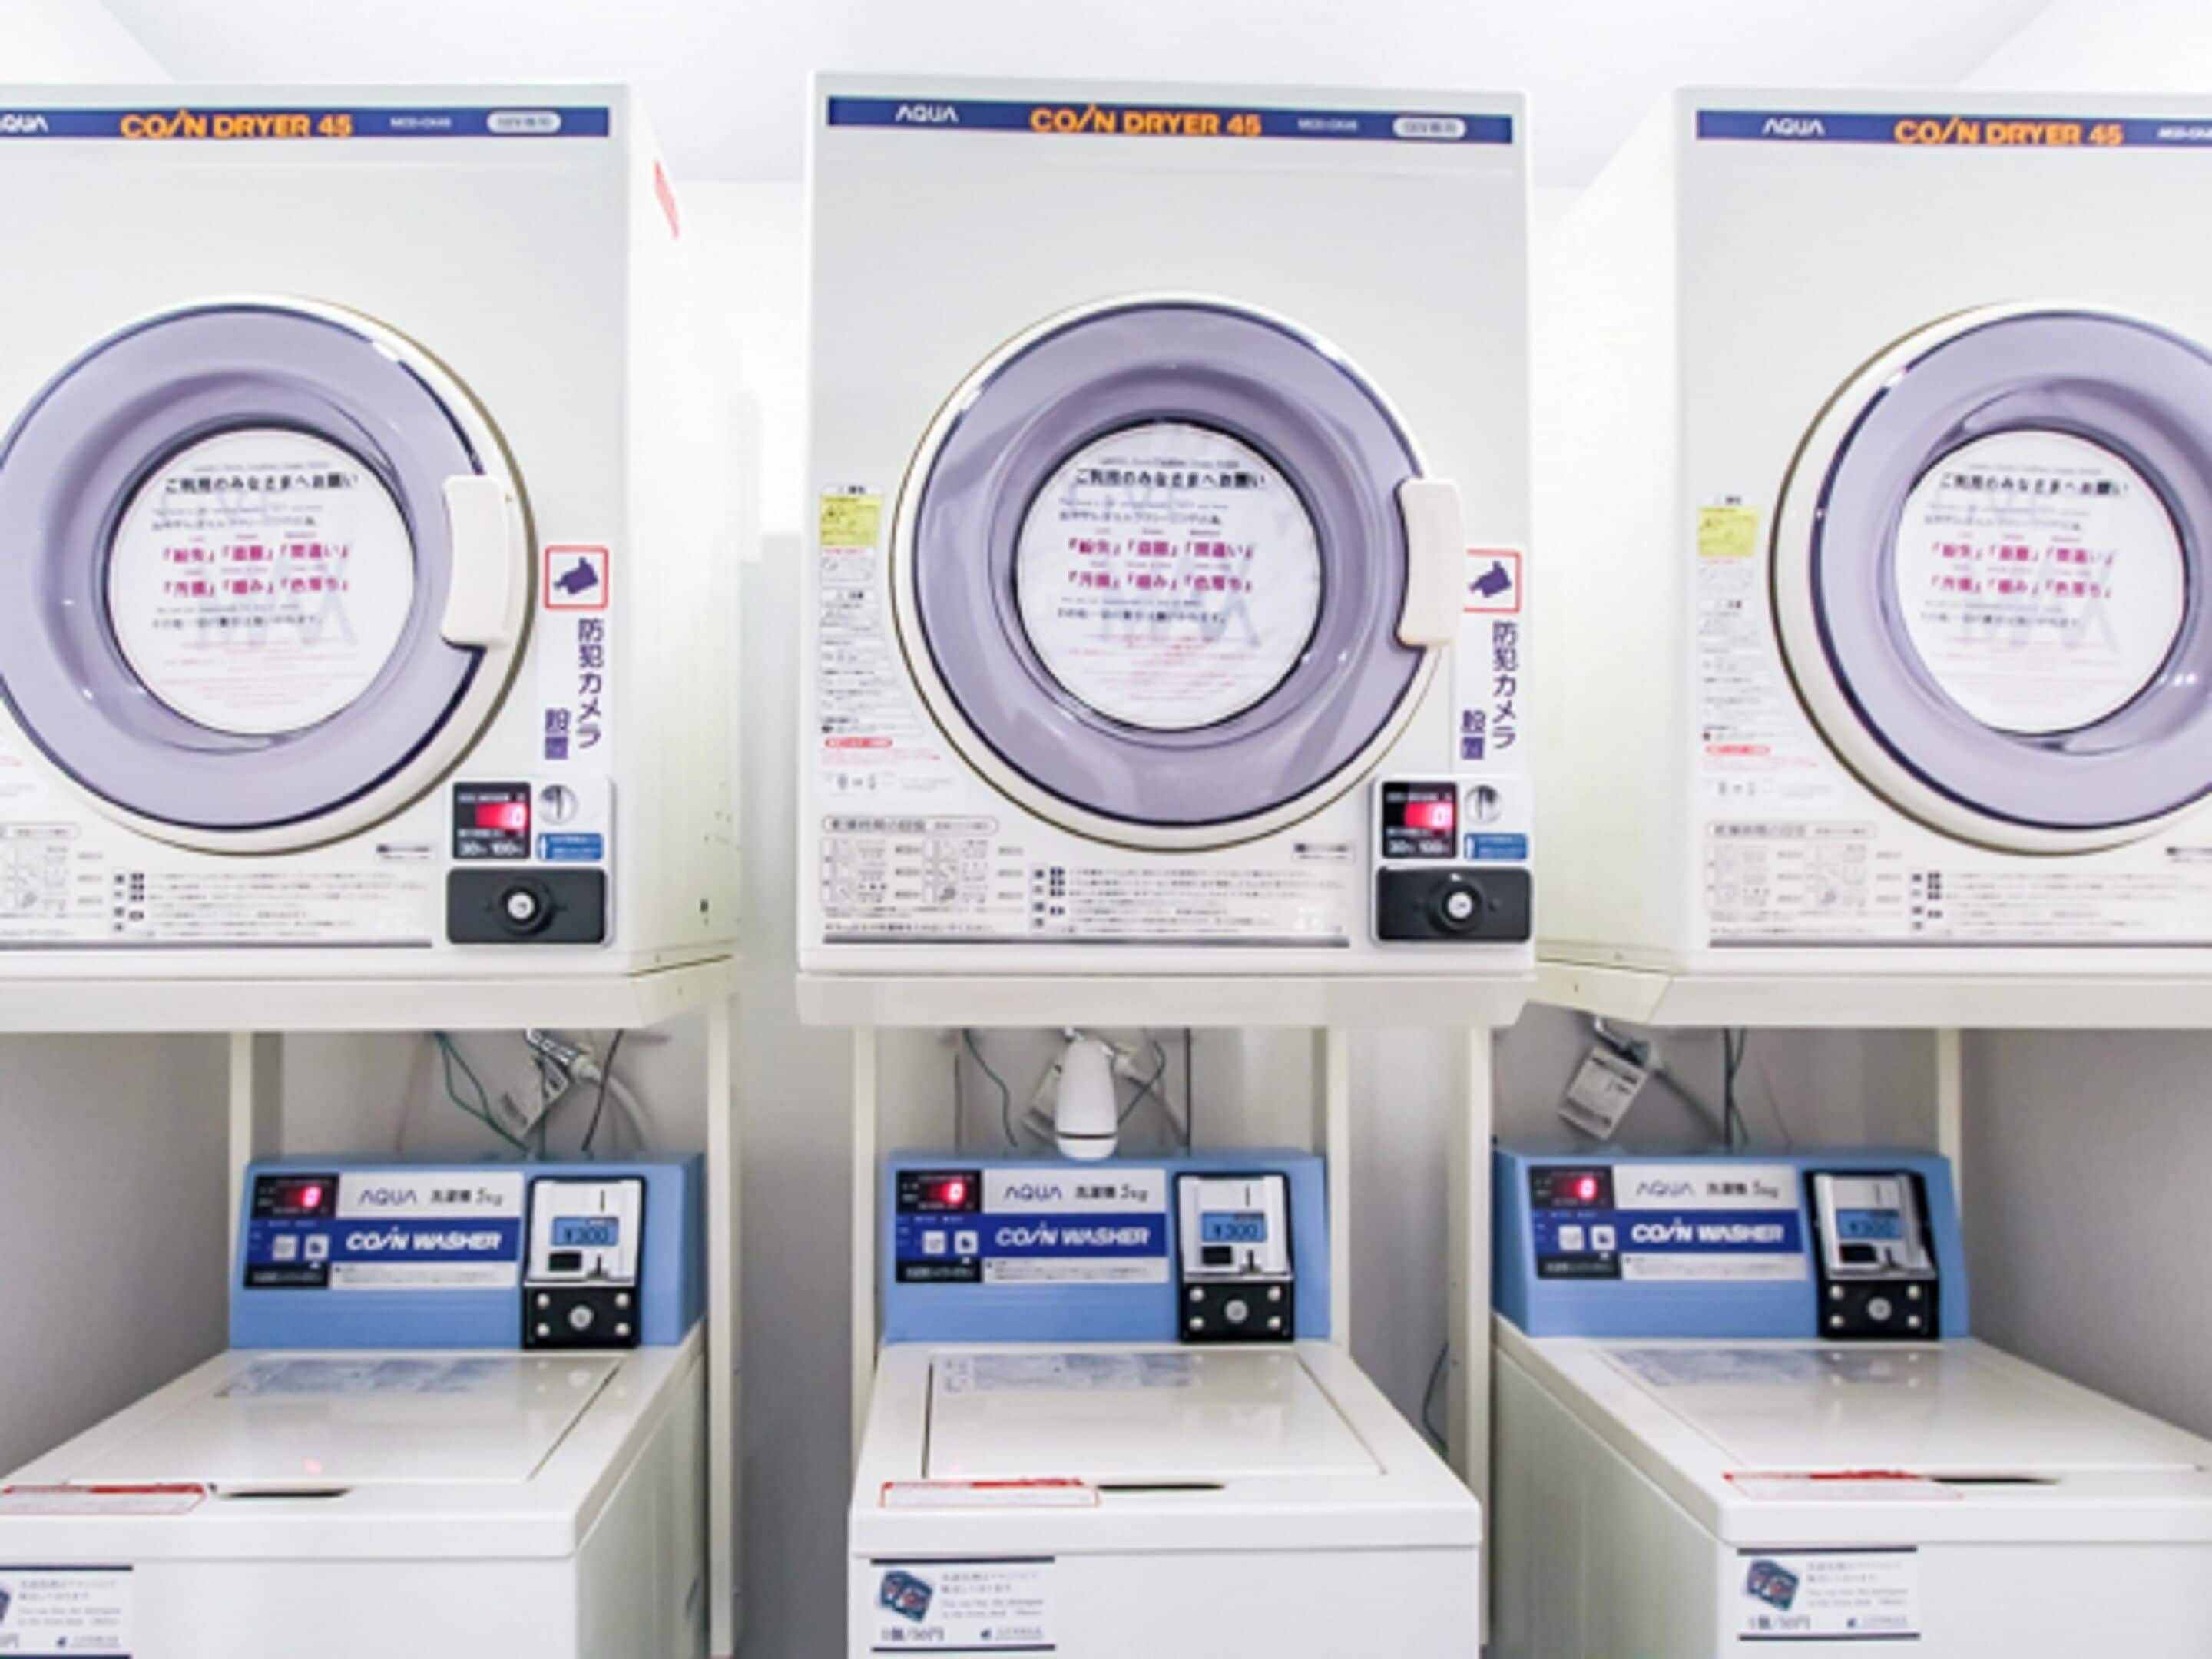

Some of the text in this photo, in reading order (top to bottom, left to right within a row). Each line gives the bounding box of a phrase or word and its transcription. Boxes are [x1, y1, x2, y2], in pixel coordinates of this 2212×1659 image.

[0, 114, 48, 133] QUA
[896, 104, 959, 123] AQUA
[213, 114, 311, 137] DRYER
[317, 114, 353, 137] 45
[1124, 111, 1217, 135] DRYER
[1227, 114, 1261, 137] 45
[1763, 118, 1825, 137] AQUA
[1986, 124, 2080, 146] DRYER
[2088, 125, 2124, 146] 45
[578, 618, 604, 749] 防犯カメラ
[1492, 621, 1518, 749] 防犯カメラ
[544, 707, 571, 760] 設置
[1461, 709, 1486, 760] 設置
[358, 1187, 418, 1207] AQUA
[1002, 1184, 1063, 1202] AQUA
[1636, 1181, 1697, 1198] AQUA
[413, 1230, 502, 1251] WASHER
[1061, 1227, 1151, 1247] WASHER
[1697, 1224, 1785, 1243] WASHER
